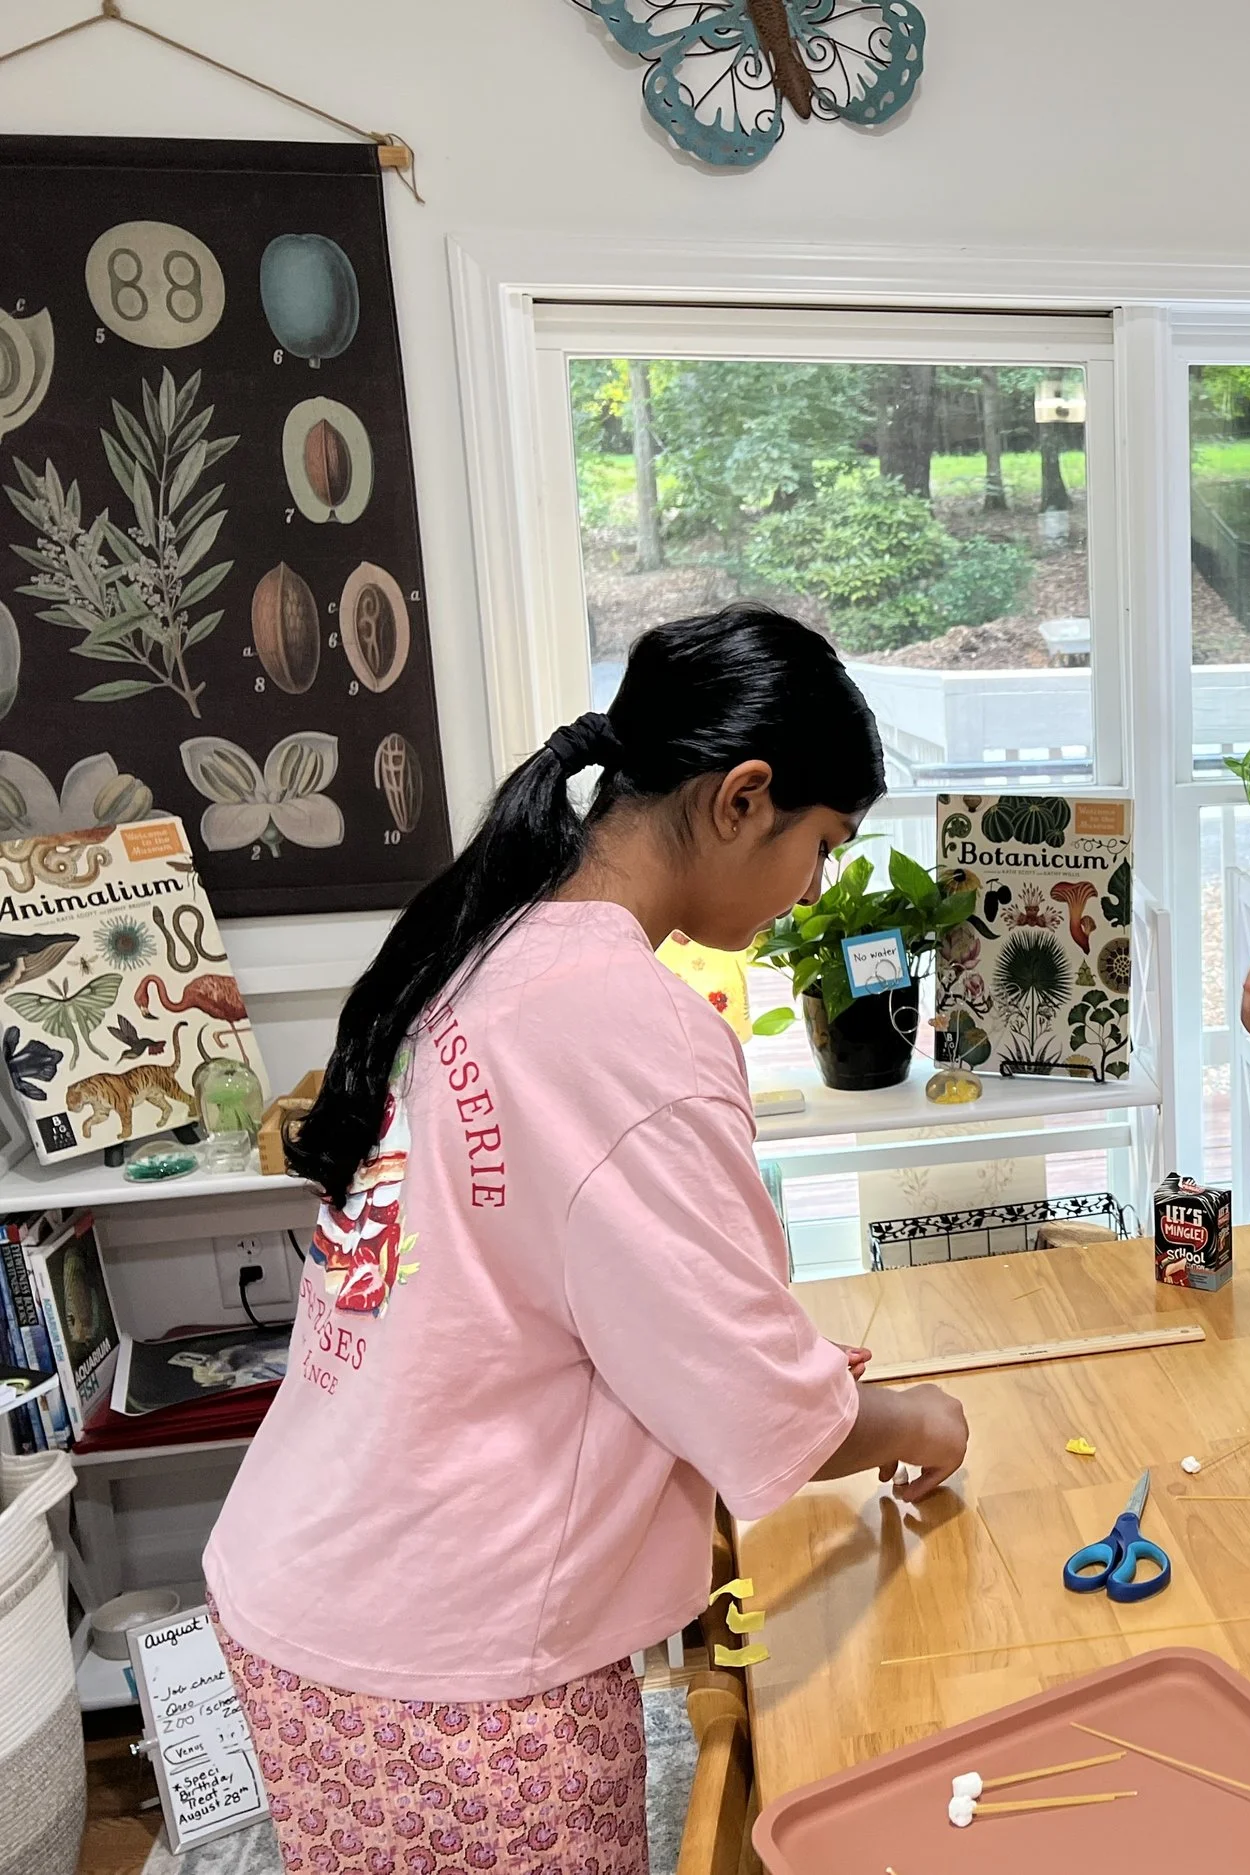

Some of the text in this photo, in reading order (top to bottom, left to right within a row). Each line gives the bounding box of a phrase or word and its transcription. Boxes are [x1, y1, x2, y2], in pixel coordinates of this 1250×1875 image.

[95, 328, 106, 344] 5
[273, 349, 284, 365] 6
[285, 508, 295, 524] 7
[254, 676, 266, 693] 8
[348, 681, 360, 696] 9
[384, 830, 401, 845] 10
[250, 845, 261, 860] 2
[957, 841, 1109, 870] Botanicum
[0, 876, 184, 922] Animalium
[853, 947, 897, 962] No water
[1165, 1204, 1204, 1227] LET'S
[1164, 1222, 1205, 1243] MINGLE!
[1166, 1247, 1206, 1264] SCHOOL
[74, 1337, 112, 1384] AQUARIUM
[78, 1373, 101, 1402] FISH
[175, 1743, 205, 1759] Venus
[179, 1773, 233, 1803] Birthday
[185, 1788, 218, 1810] Treat
[179, 1799, 221, 1825] August
